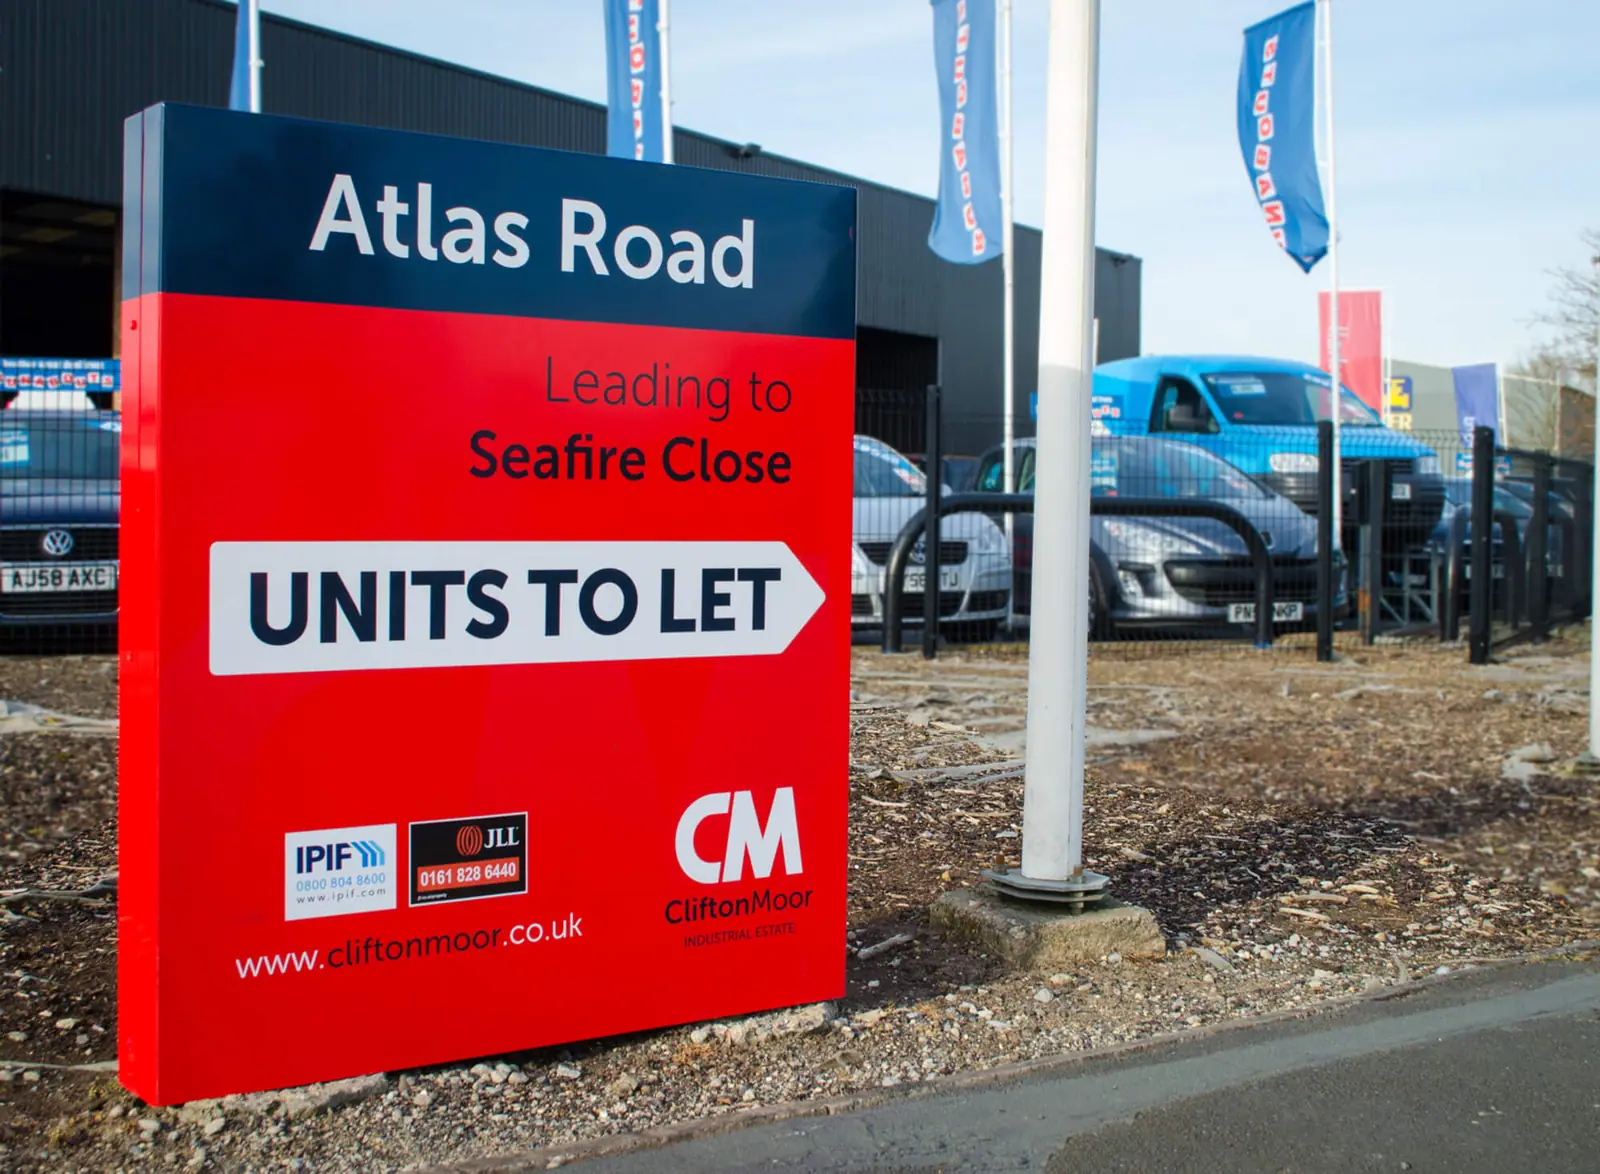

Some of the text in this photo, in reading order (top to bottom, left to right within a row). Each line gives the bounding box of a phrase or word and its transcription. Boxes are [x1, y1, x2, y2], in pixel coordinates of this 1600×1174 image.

[309, 174, 755, 289] Atlas Road
[547, 356, 792, 422] Leading to
[470, 430, 791, 484] Seafire Close
[12, 569, 106, 589] AJ58 AXC
[251, 568, 781, 646] UNITS TO LET
[484, 827, 519, 848] JLL
[675, 787, 803, 884] CM
[296, 843, 352, 874] IPIF
[420, 862, 516, 887] 0161 828 6440
[296, 872, 386, 891] 0800 804 8600
[296, 887, 386, 904] www.ipif.com
[665, 889, 813, 924] CliftonMoor
[236, 913, 583, 979] www.cliftonmoor.co.uk
[684, 922, 795, 948] INDUSTRIAL ESTATE
